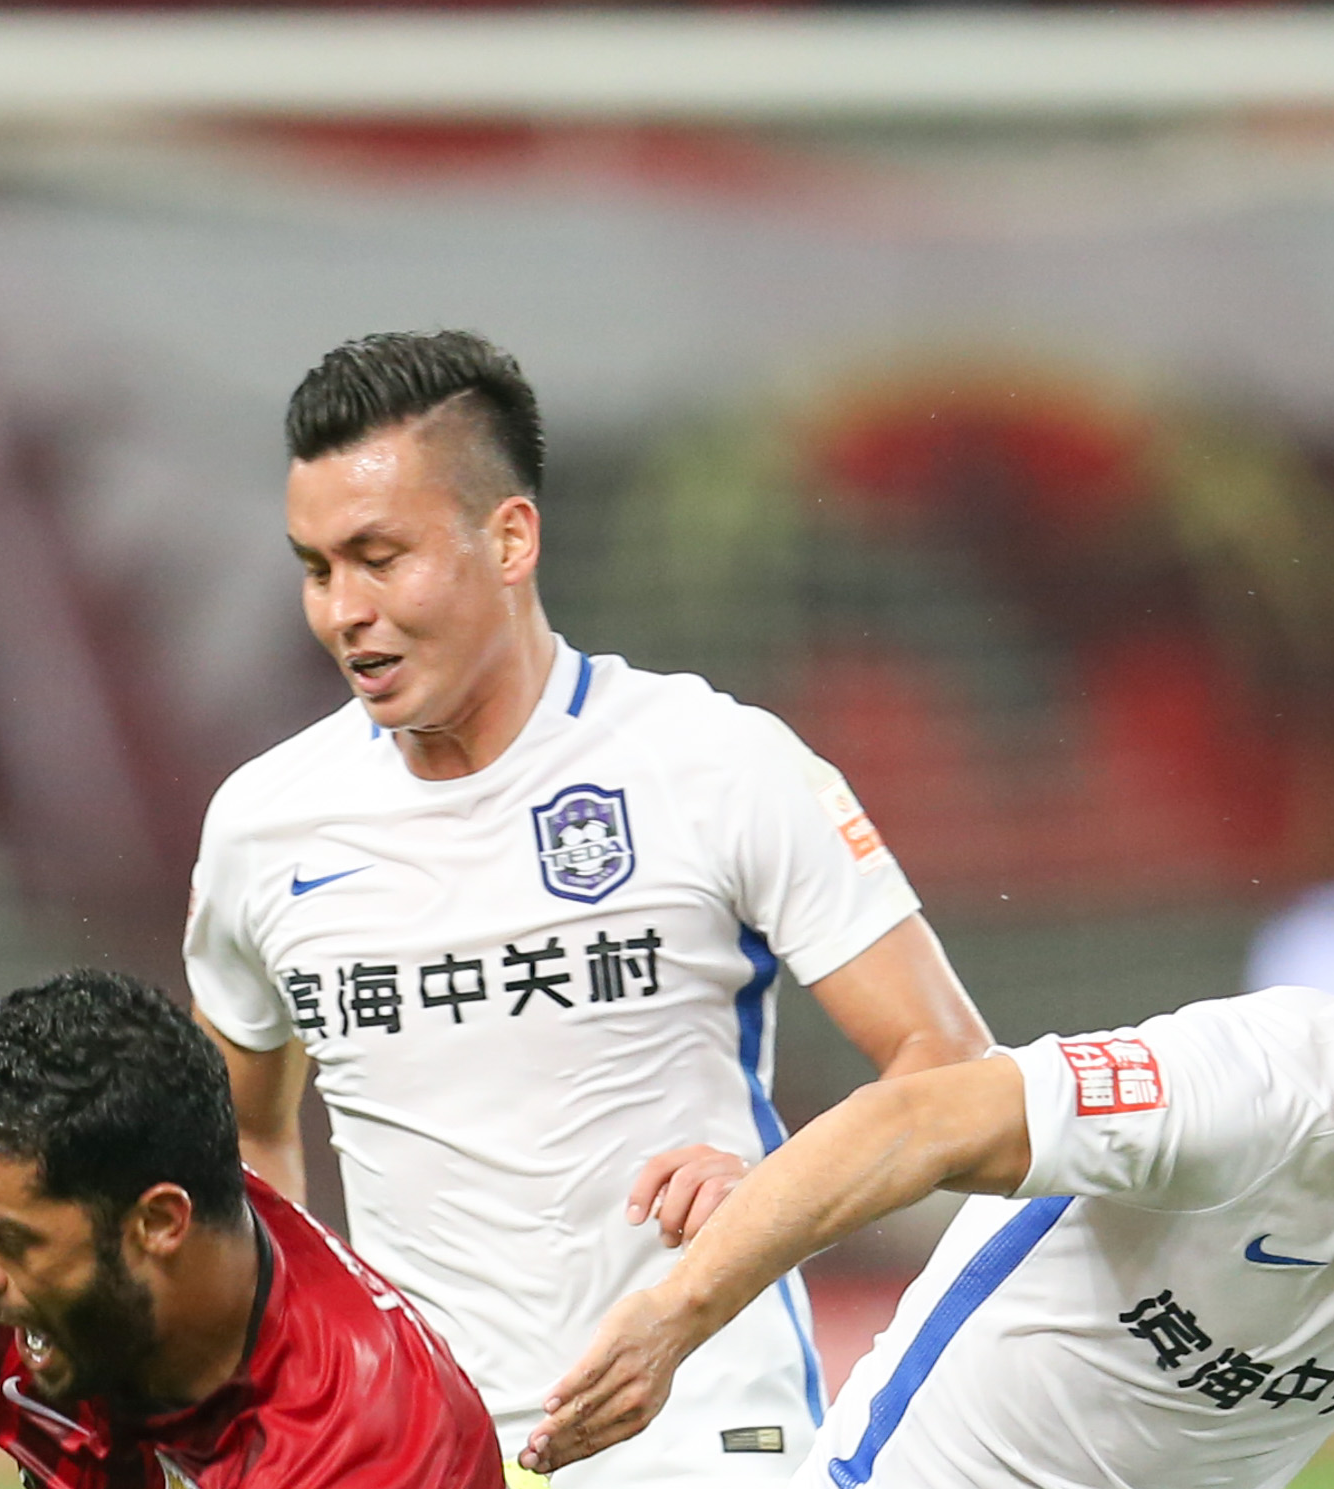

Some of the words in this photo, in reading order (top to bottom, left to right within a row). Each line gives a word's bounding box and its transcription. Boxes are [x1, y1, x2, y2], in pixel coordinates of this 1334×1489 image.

[543, 840, 624, 868] TEDA
[279, 928, 662, 1039] 滨海中关村
